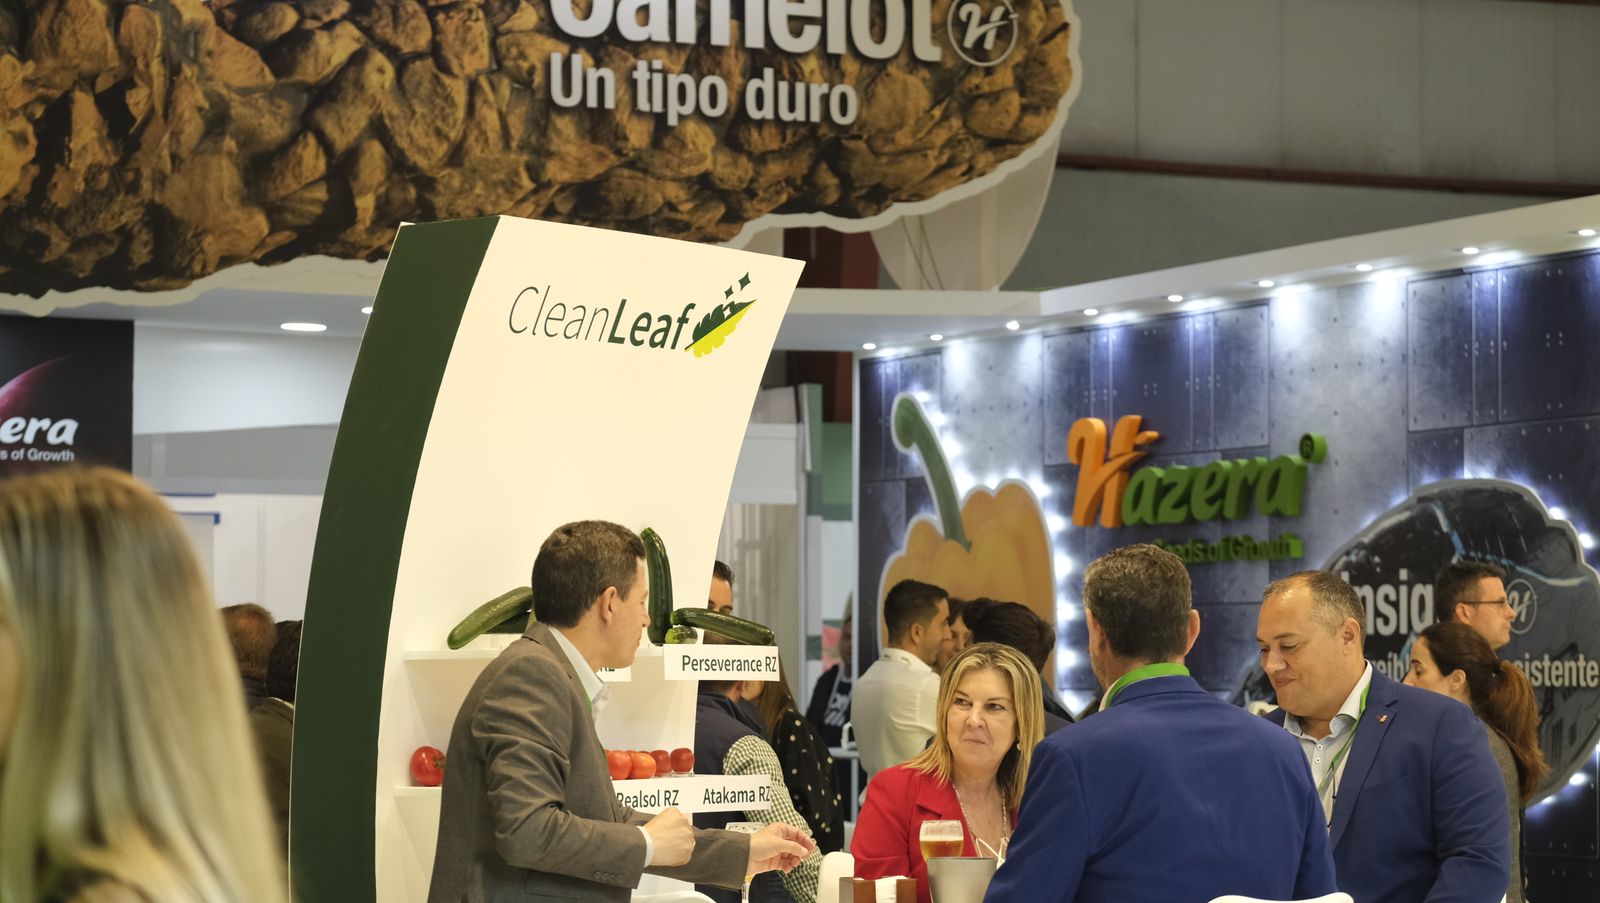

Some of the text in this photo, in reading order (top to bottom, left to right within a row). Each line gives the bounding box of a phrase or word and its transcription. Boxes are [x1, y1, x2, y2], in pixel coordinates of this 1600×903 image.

[550, 52, 858, 126] Un tipo duro
[508, 285, 697, 350] CleanLeaf
[10, 448, 25, 461] of
[27, 448, 75, 462] Growth
[681, 654, 777, 673] Perseverance RZ
[664, 789, 679, 807] RZ
[703, 785, 771, 805] Atakama RZ
